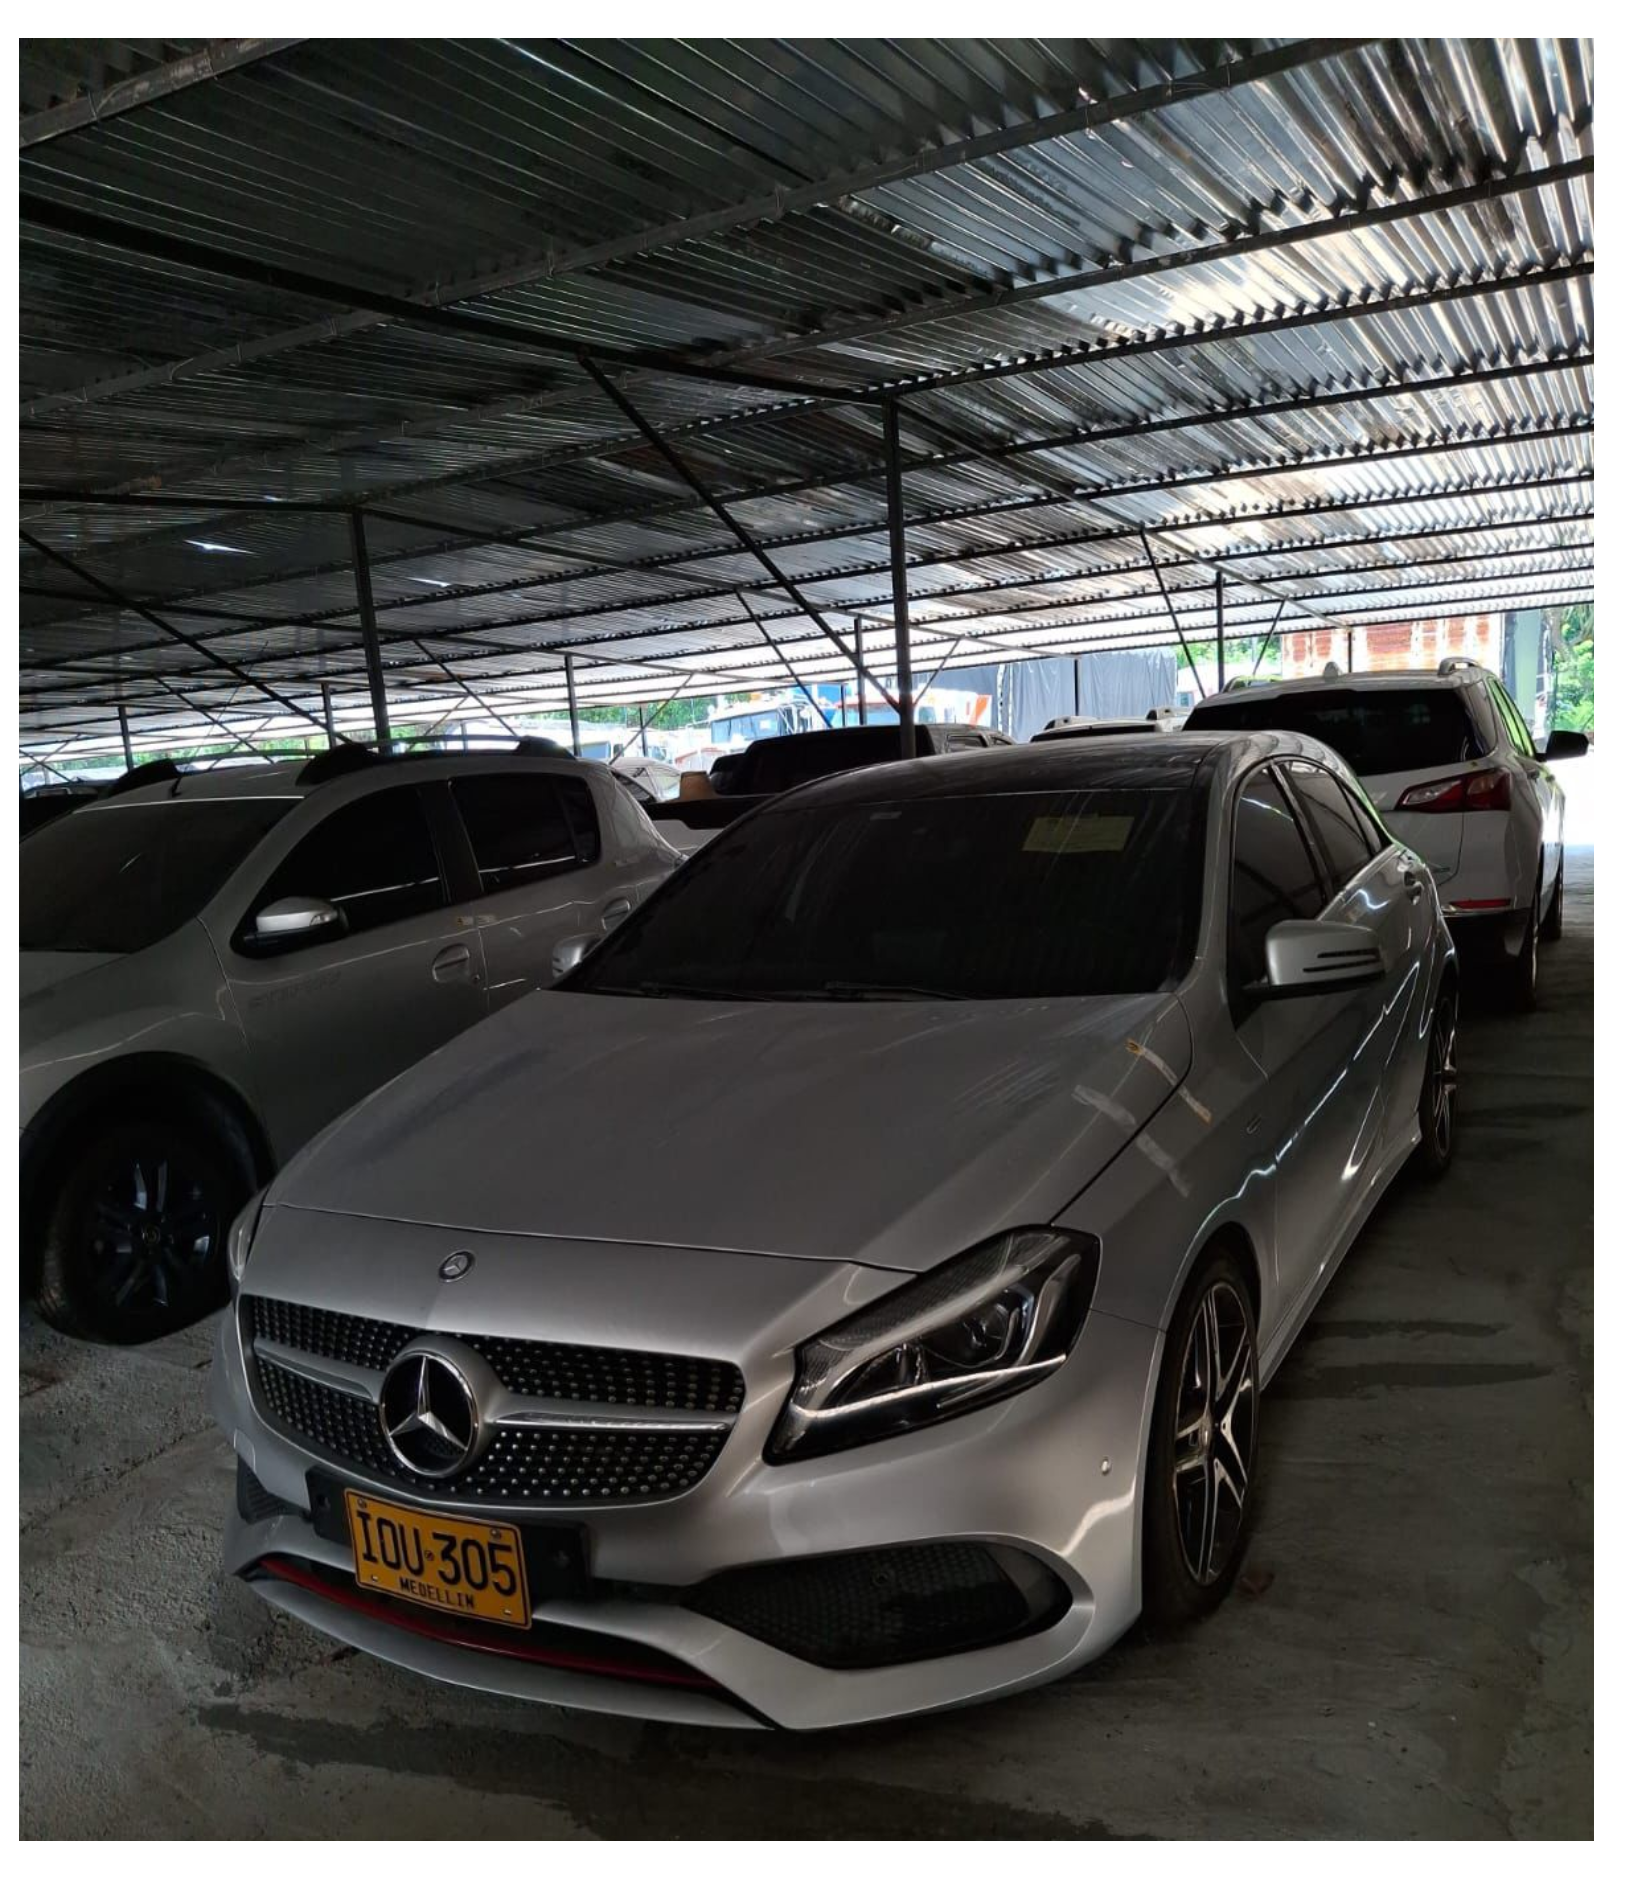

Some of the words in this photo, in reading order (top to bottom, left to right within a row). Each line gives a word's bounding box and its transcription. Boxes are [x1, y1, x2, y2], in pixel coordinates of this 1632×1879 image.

[357, 1511, 424, 1576] IOU
[432, 1532, 517, 1597] 305
[400, 1577, 474, 1609] MEDELLIN
